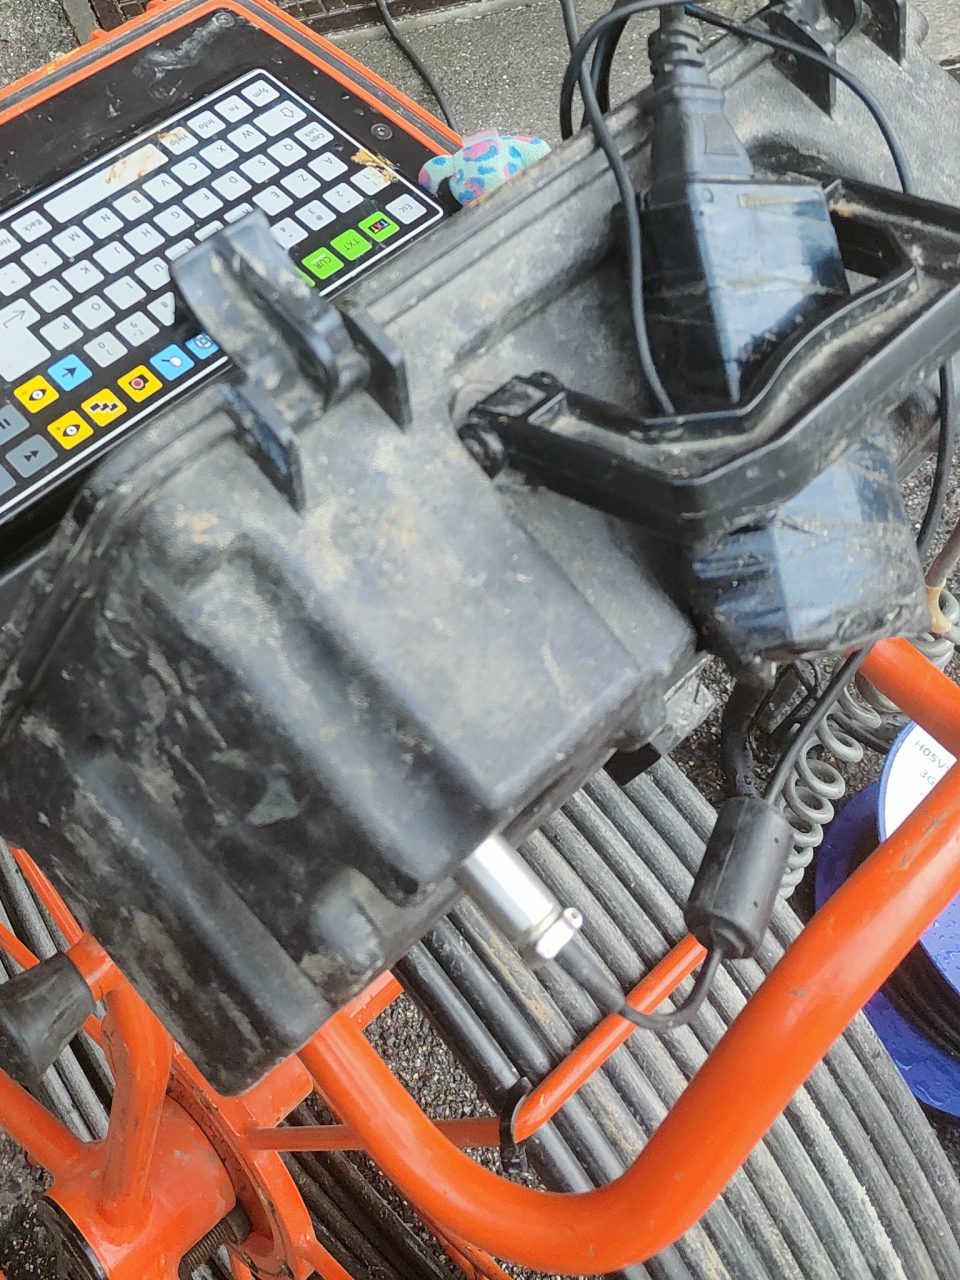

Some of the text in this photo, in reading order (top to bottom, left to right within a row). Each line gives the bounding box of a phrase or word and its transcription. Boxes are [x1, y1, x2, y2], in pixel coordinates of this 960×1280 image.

[252, 86, 269, 98] Sym
[198, 118, 216, 129] Info
[241, 130, 254, 139] W
[170, 134, 189, 146] Help
[216, 144, 227, 153] X
[283, 143, 294, 152] Q
[188, 162, 198, 170] C
[398, 203, 413, 213] Esc
[101, 214, 110, 222] N
[171, 211, 180, 219] G
[23, 219, 44, 233] Back
[371, 220, 389, 233] TXT
[68, 232, 80, 241] M
[141, 229, 152, 237] H
[344, 238, 360, 251] TXT
[314, 256, 332, 269] CUR
[154, 264, 163, 272] U
[50, 284, 59, 292] L
[91, 302, 101, 311] O
[63, 322, 70, 330] P
